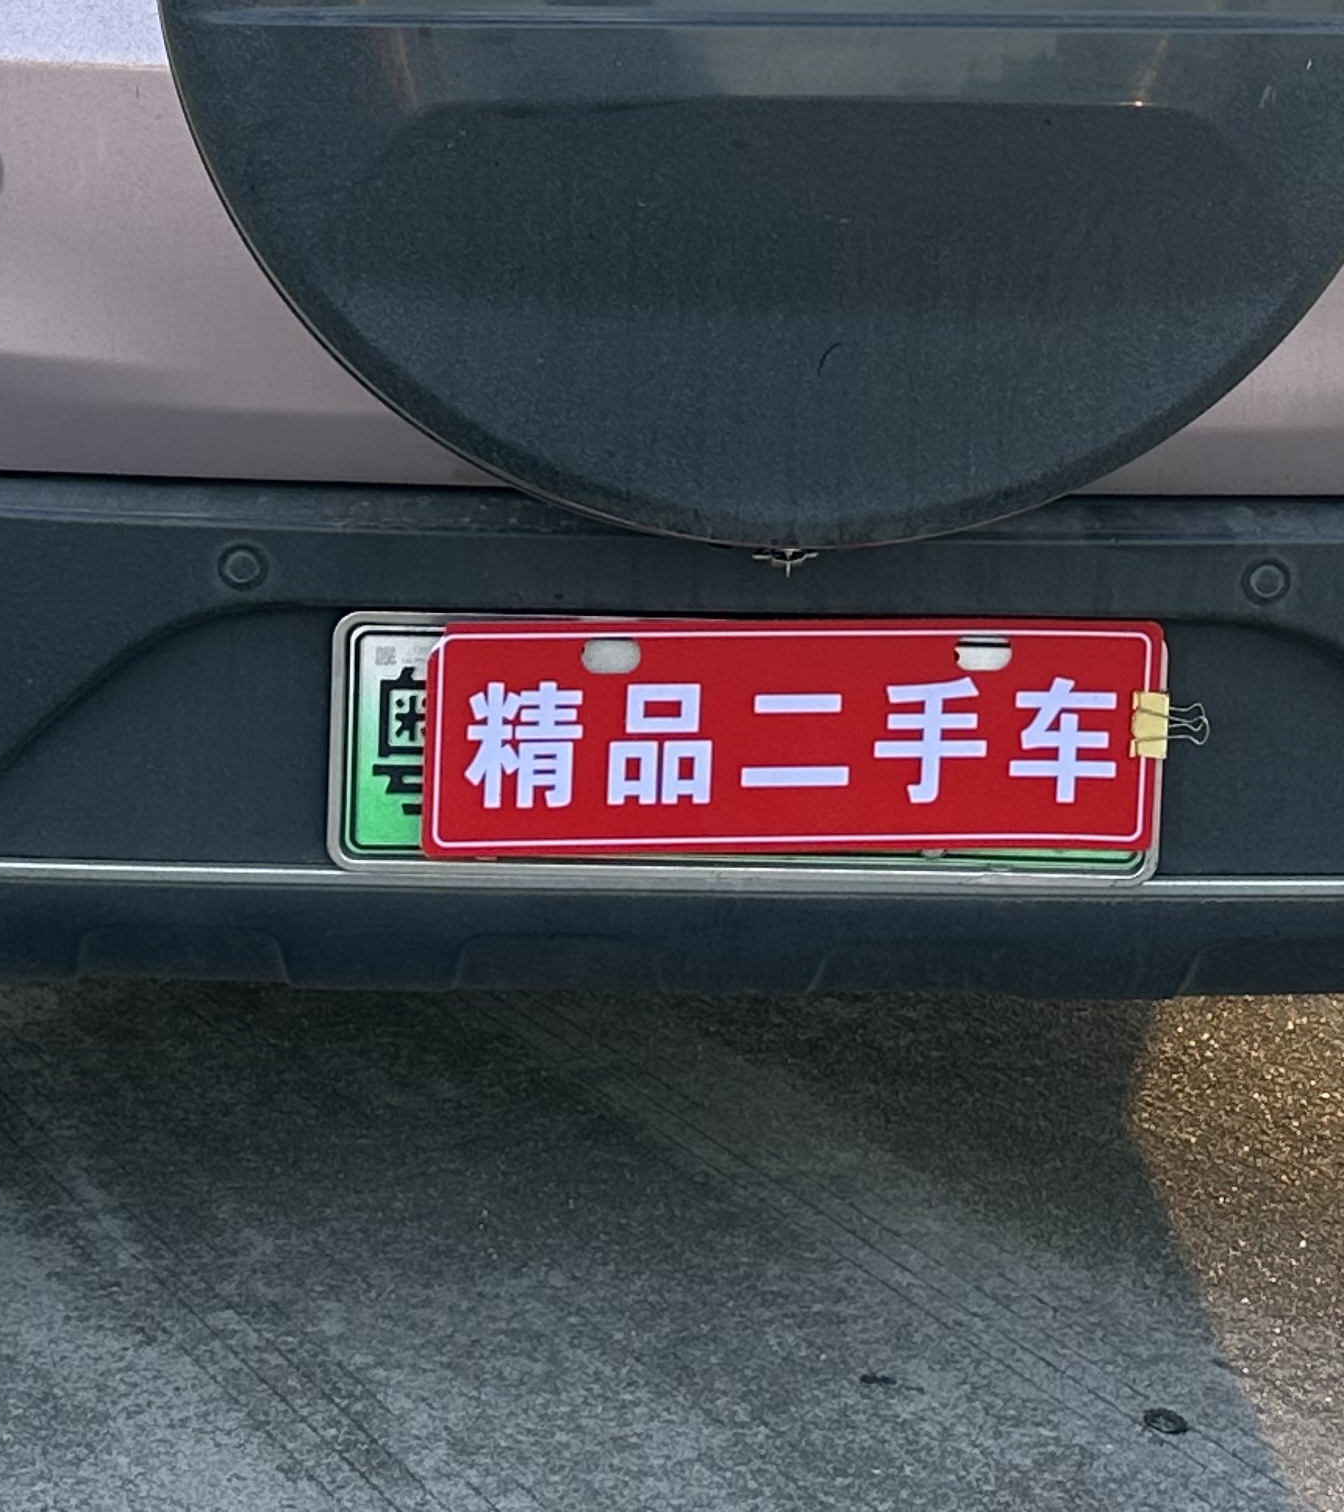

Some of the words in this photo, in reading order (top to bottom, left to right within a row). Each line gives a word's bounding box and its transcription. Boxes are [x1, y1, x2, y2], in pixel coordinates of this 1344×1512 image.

[465, 679, 1119, 809] 精品二手车
